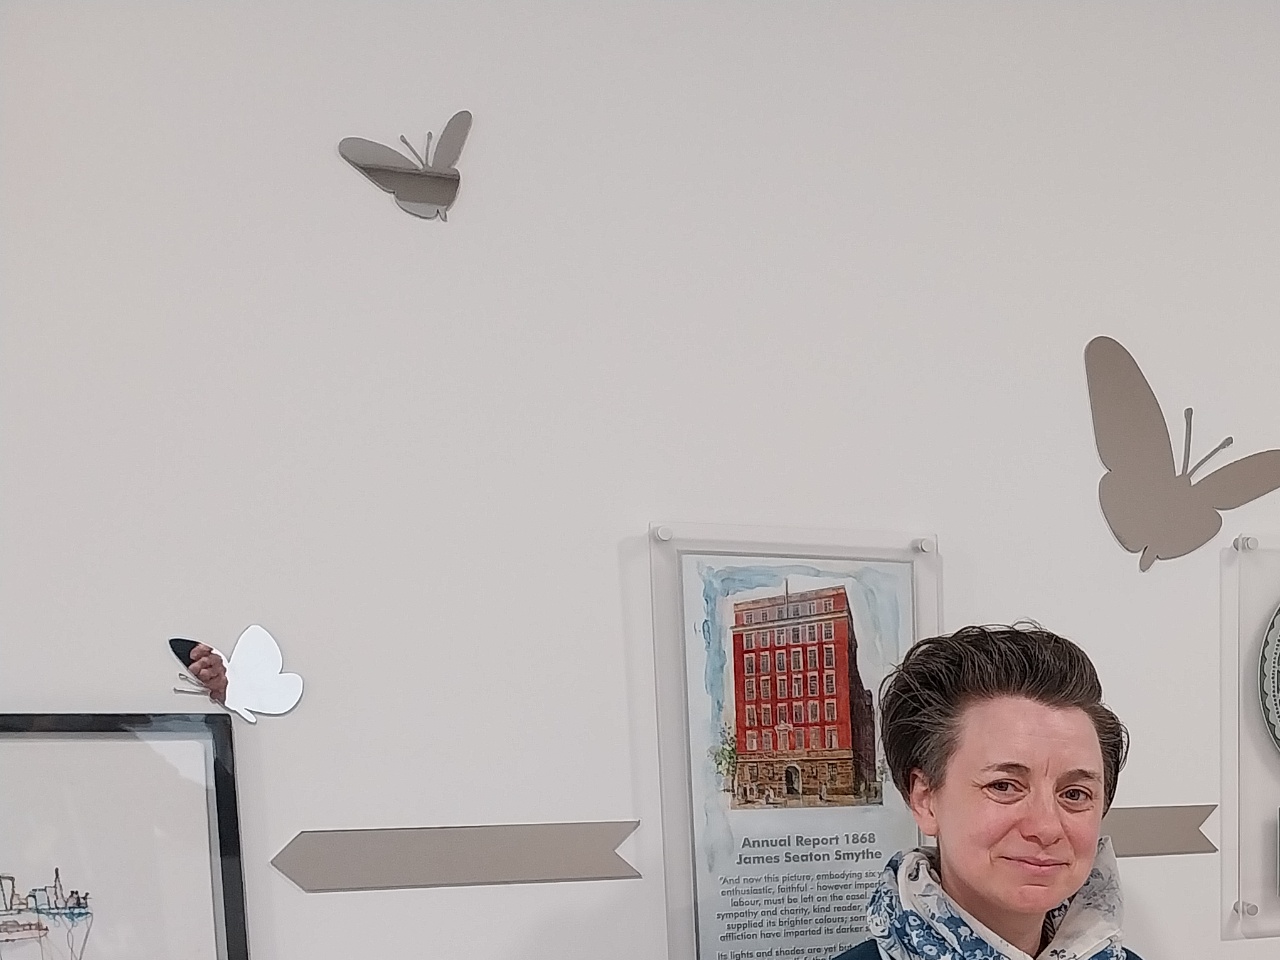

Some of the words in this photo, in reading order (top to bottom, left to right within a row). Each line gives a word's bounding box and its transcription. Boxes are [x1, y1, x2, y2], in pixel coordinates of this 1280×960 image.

[741, 835, 791, 849] Annual
[796, 834, 840, 849] Report
[844, 832, 876, 845] 1868
[736, 853, 781, 865] James
[784, 850, 831, 863] Seaton
[834, 848, 883, 863] Smythe
[742, 876, 763, 884] now
[763, 873, 780, 883] this
[781, 873, 814, 884] picture,
[816, 870, 863, 881] embodying
[864, 869, 876, 878] six
[720, 885, 776, 897] enthusiastic,
[777, 883, 808, 894] faithful
[816, 882, 852, 892] however
[730, 898, 762, 907] labour,
[763, 896, 785, 906] must
[787, 894, 798, 904] be
[800, 893, 814, 903] left
[816, 895, 827, 903] on
[829, 892, 843, 901] the
[716, 908, 759, 921] sympathy
[760, 906, 778, 917] and
[780, 905, 811, 917] charity,
[812, 903, 831, 913] kind
[833, 902, 863, 913] reader,
[726, 919, 764, 931] supplied
[766, 919, 777, 928] its
[779, 916, 813, 928] brighter
[814, 914, 848, 924] colours;
[719, 931, 758, 942] affliction
[760, 930, 782, 939] have
[783, 926, 822, 939] imparted
[824, 925, 834, 935] its
[835, 924, 864, 934] darker
[717, 951, 728, 960] Its
[730, 949, 754, 960] lights
[755, 947, 773, 958] and
[775, 946, 805, 957] shades
[807, 946, 822, 954] are
[823, 944, 837, 955] yet
